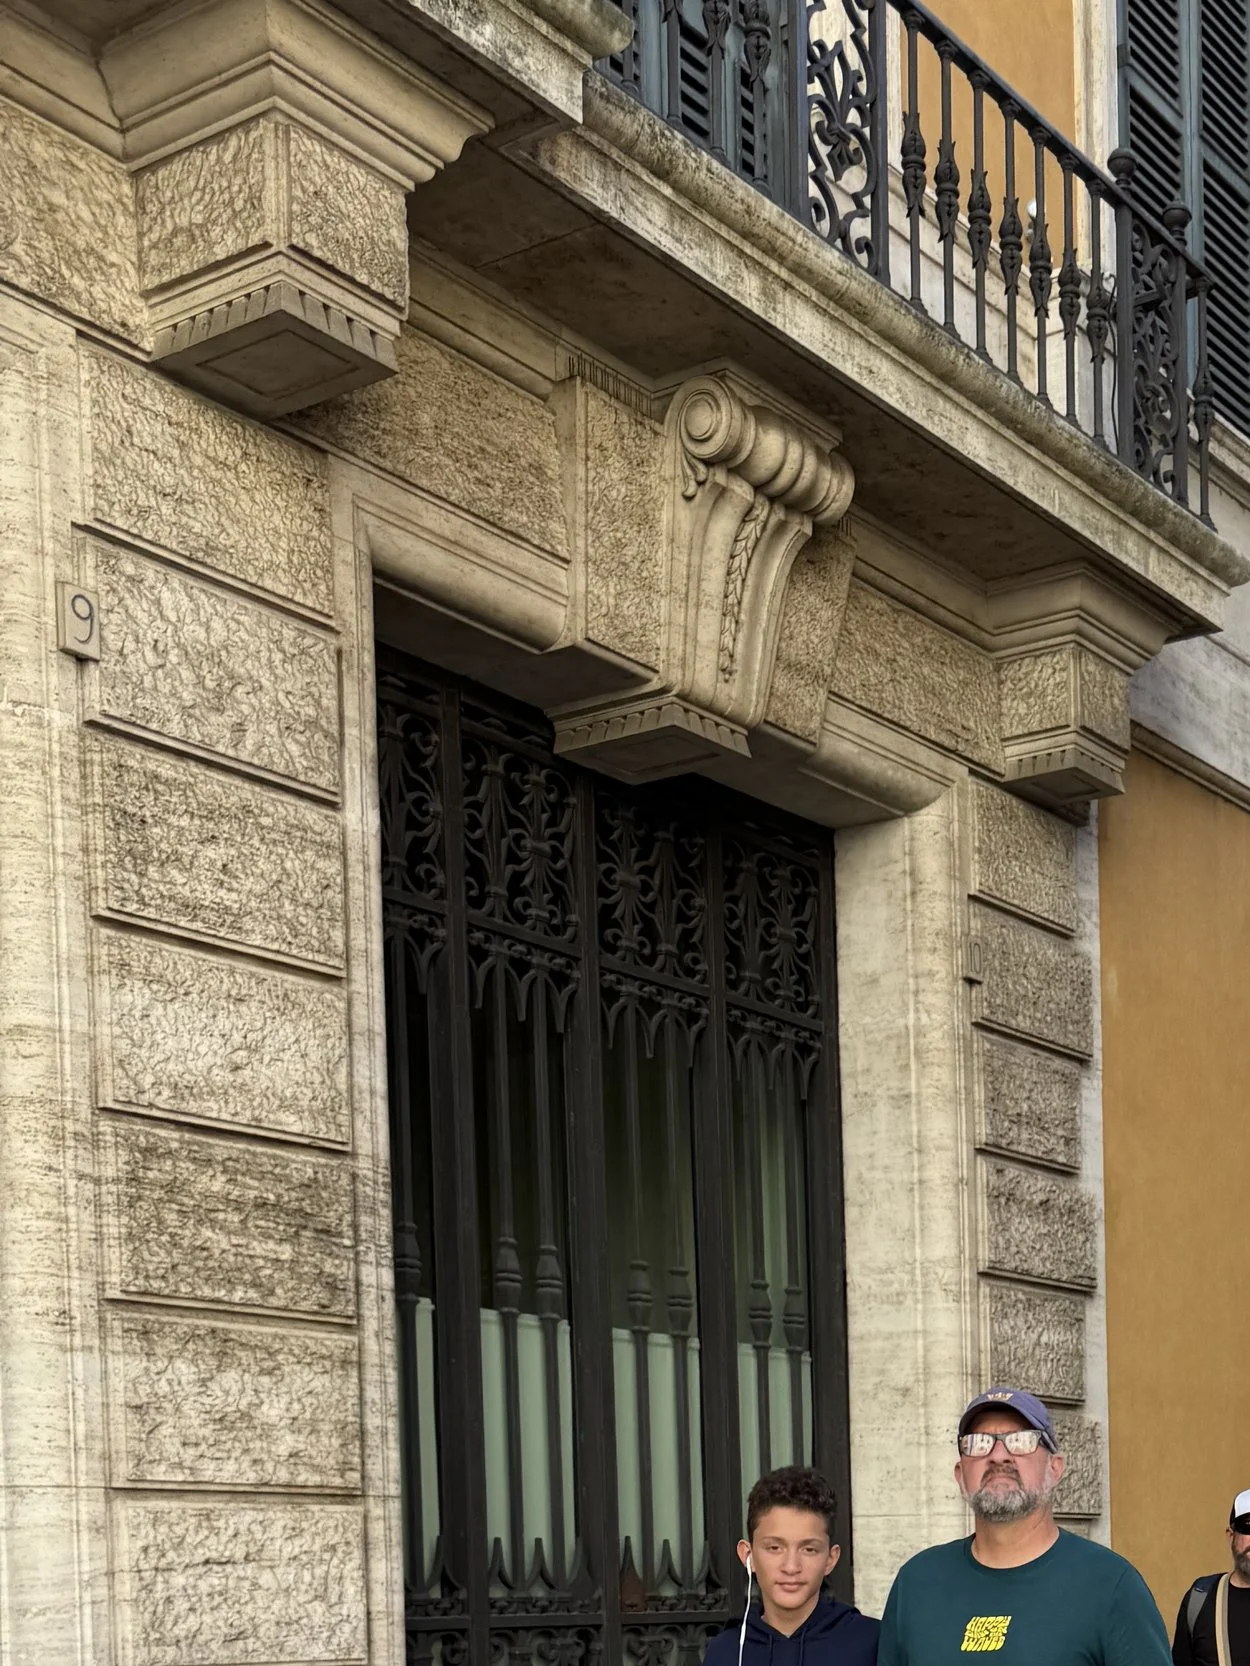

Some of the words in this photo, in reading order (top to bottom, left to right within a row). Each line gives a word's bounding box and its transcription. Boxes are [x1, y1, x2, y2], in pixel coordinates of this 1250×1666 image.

[71, 594, 94, 645] 9
[969, 942, 981, 974] 10
[966, 1615, 1012, 1631] HAPPY
